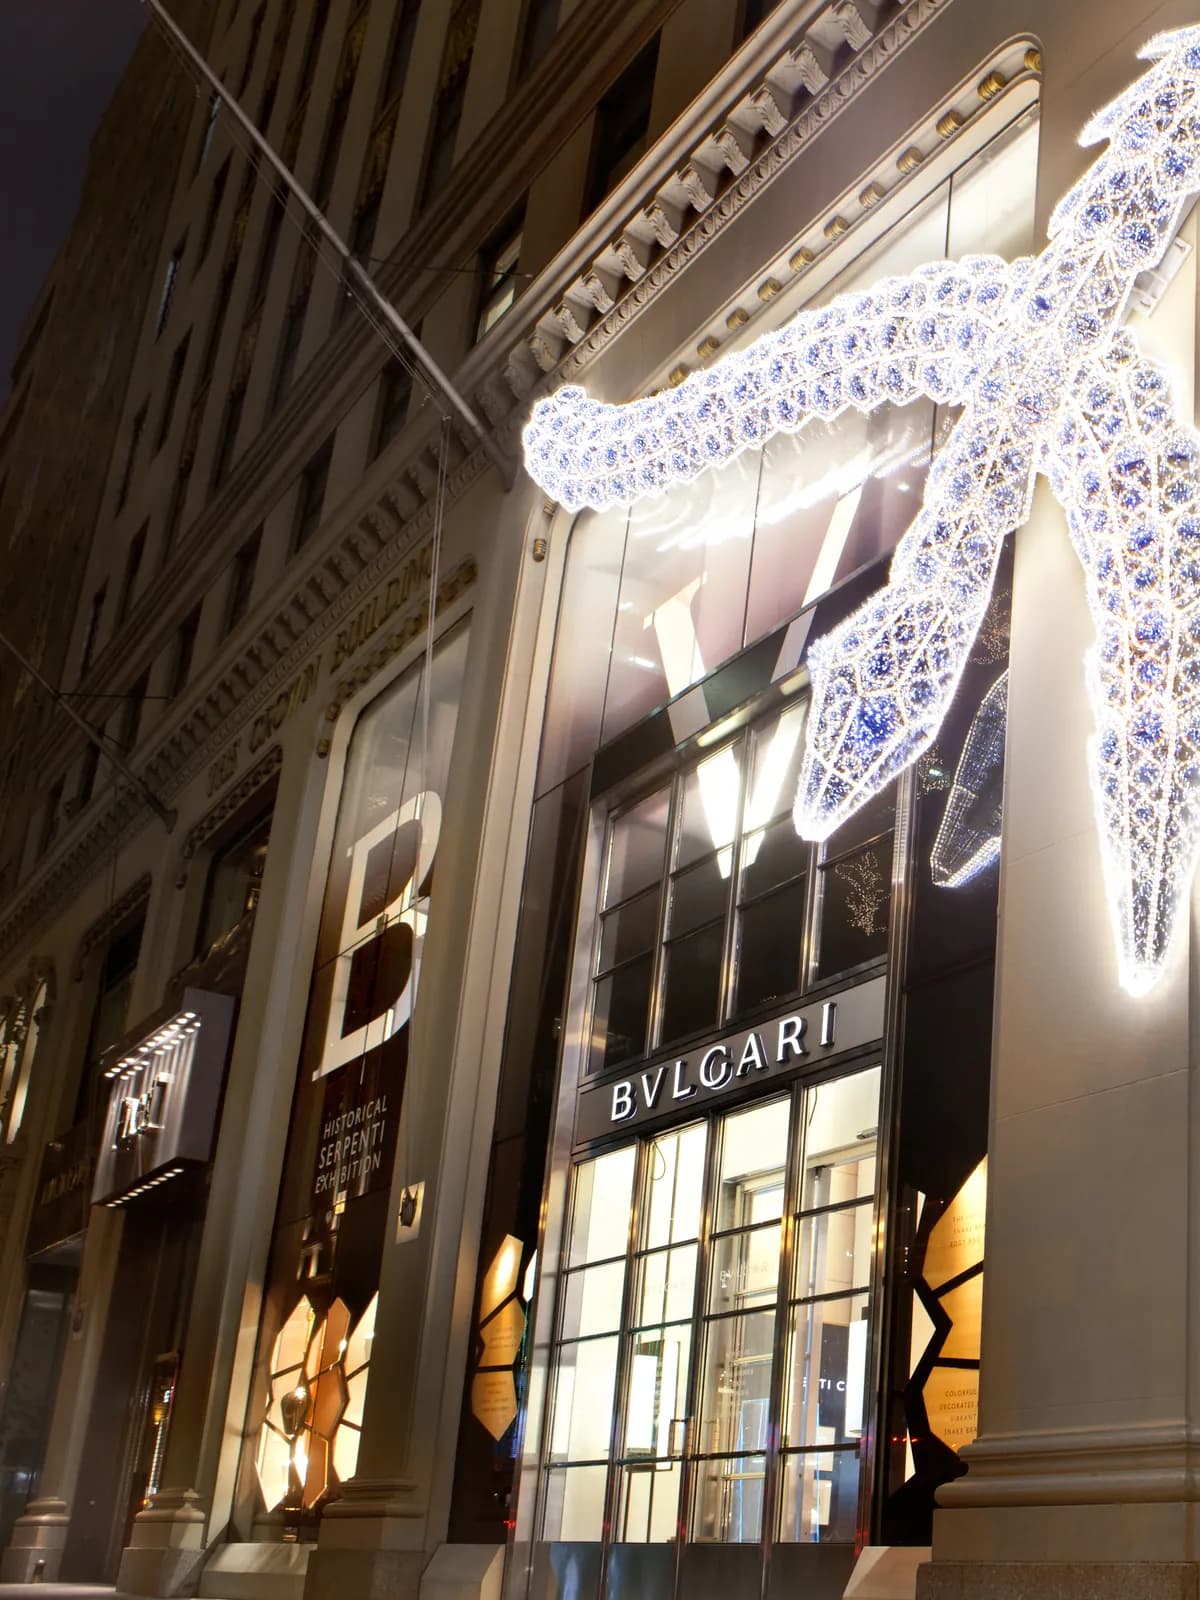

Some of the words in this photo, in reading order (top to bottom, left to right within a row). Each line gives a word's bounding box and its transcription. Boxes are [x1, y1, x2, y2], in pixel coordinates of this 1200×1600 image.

[610, 1002, 838, 1123] BVLGARI
[323, 1095, 388, 1140] HISTORICAL
[318, 1120, 386, 1169] SERPENTI
[314, 1151, 382, 1194] EXHIBITION
